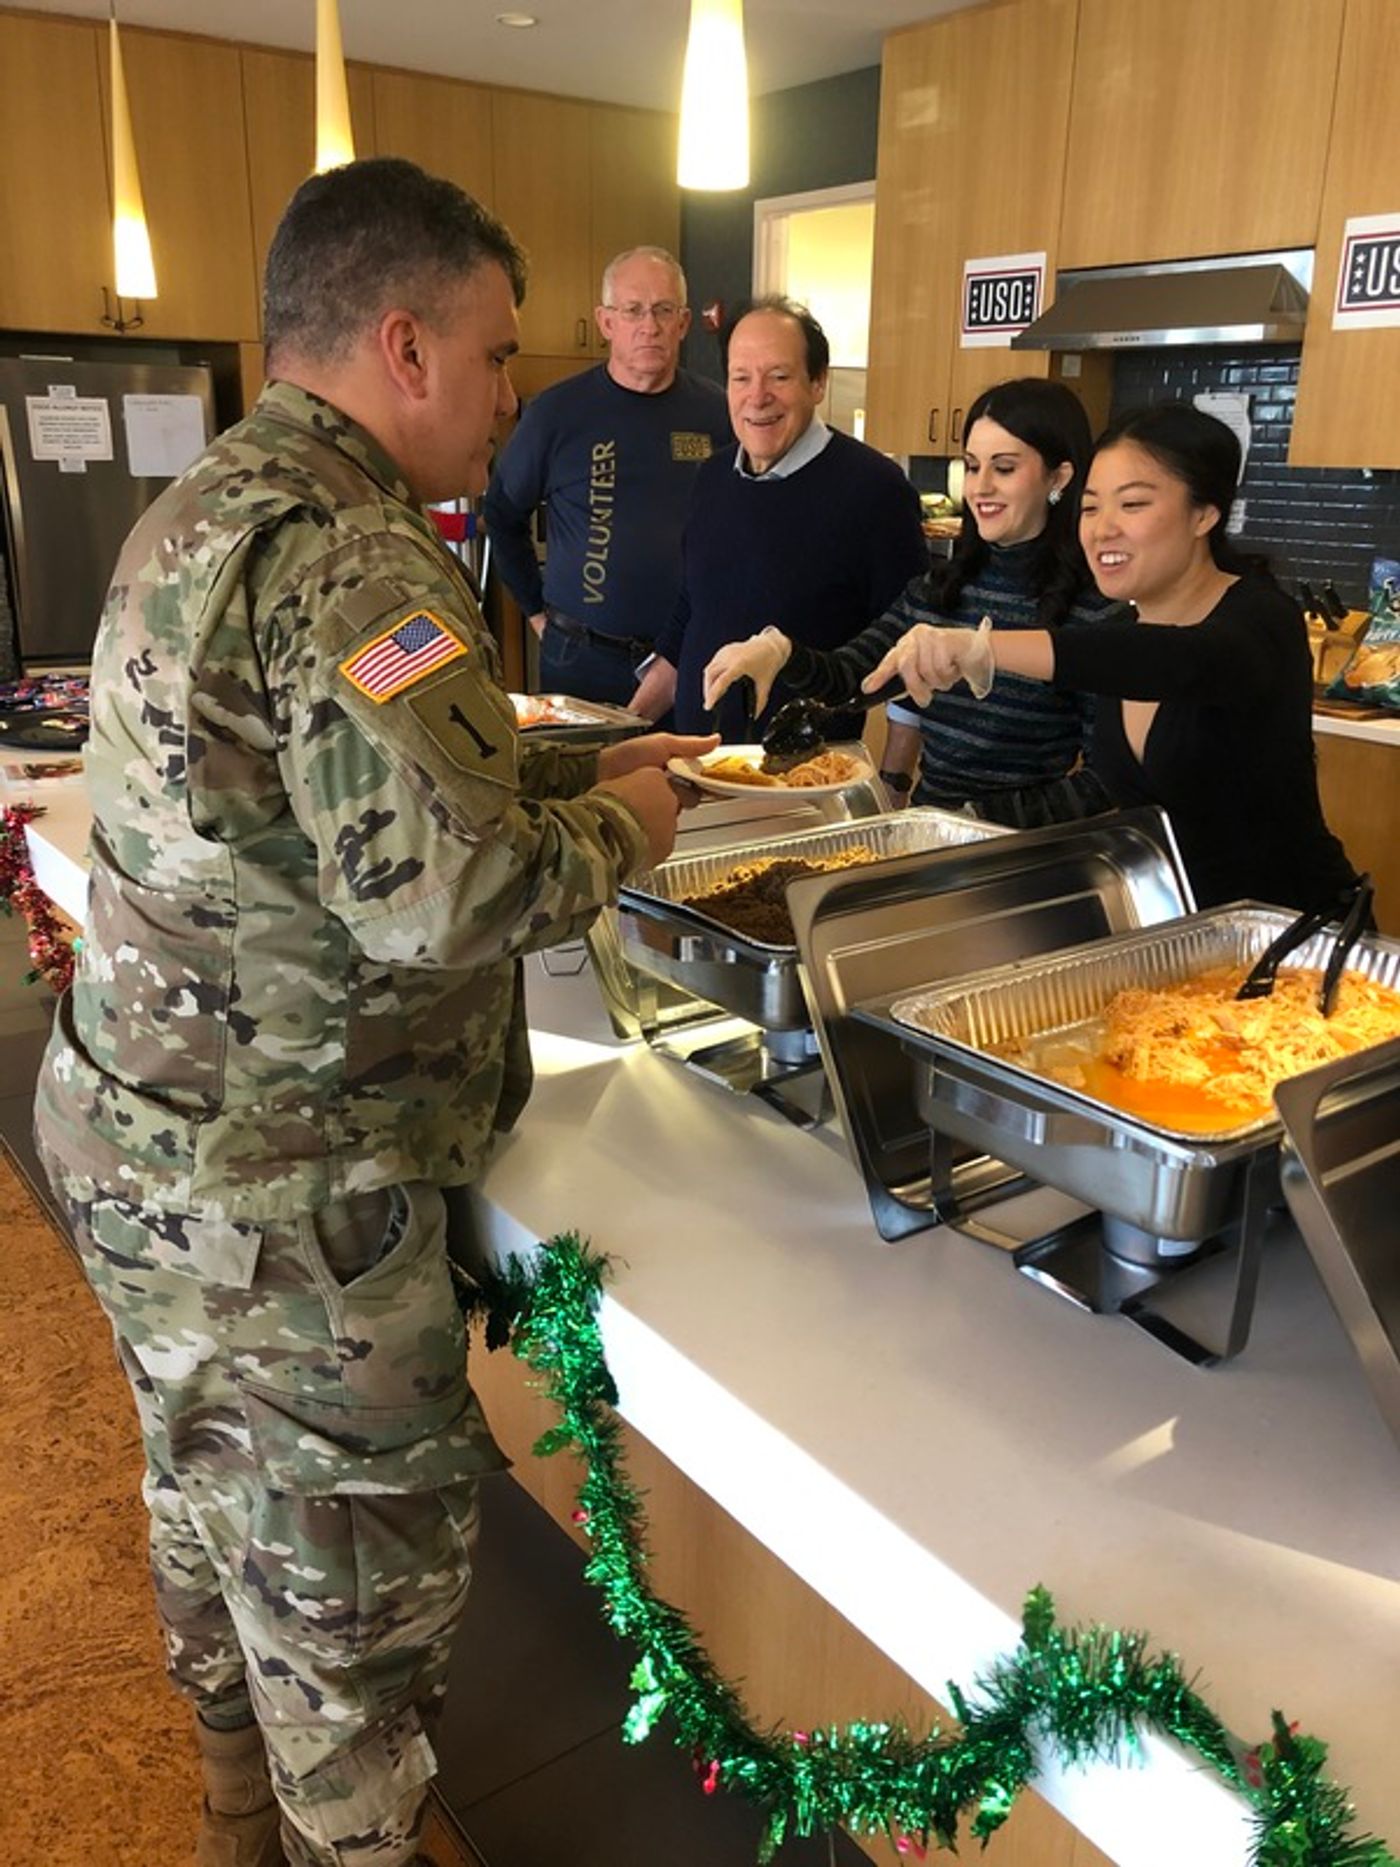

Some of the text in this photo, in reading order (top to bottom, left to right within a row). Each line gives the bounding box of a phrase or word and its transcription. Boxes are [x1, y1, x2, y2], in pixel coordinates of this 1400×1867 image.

[979, 280, 1024, 323] USO
[582, 440, 616, 603] VOLUNTEER
[448, 702, 499, 760] 1
